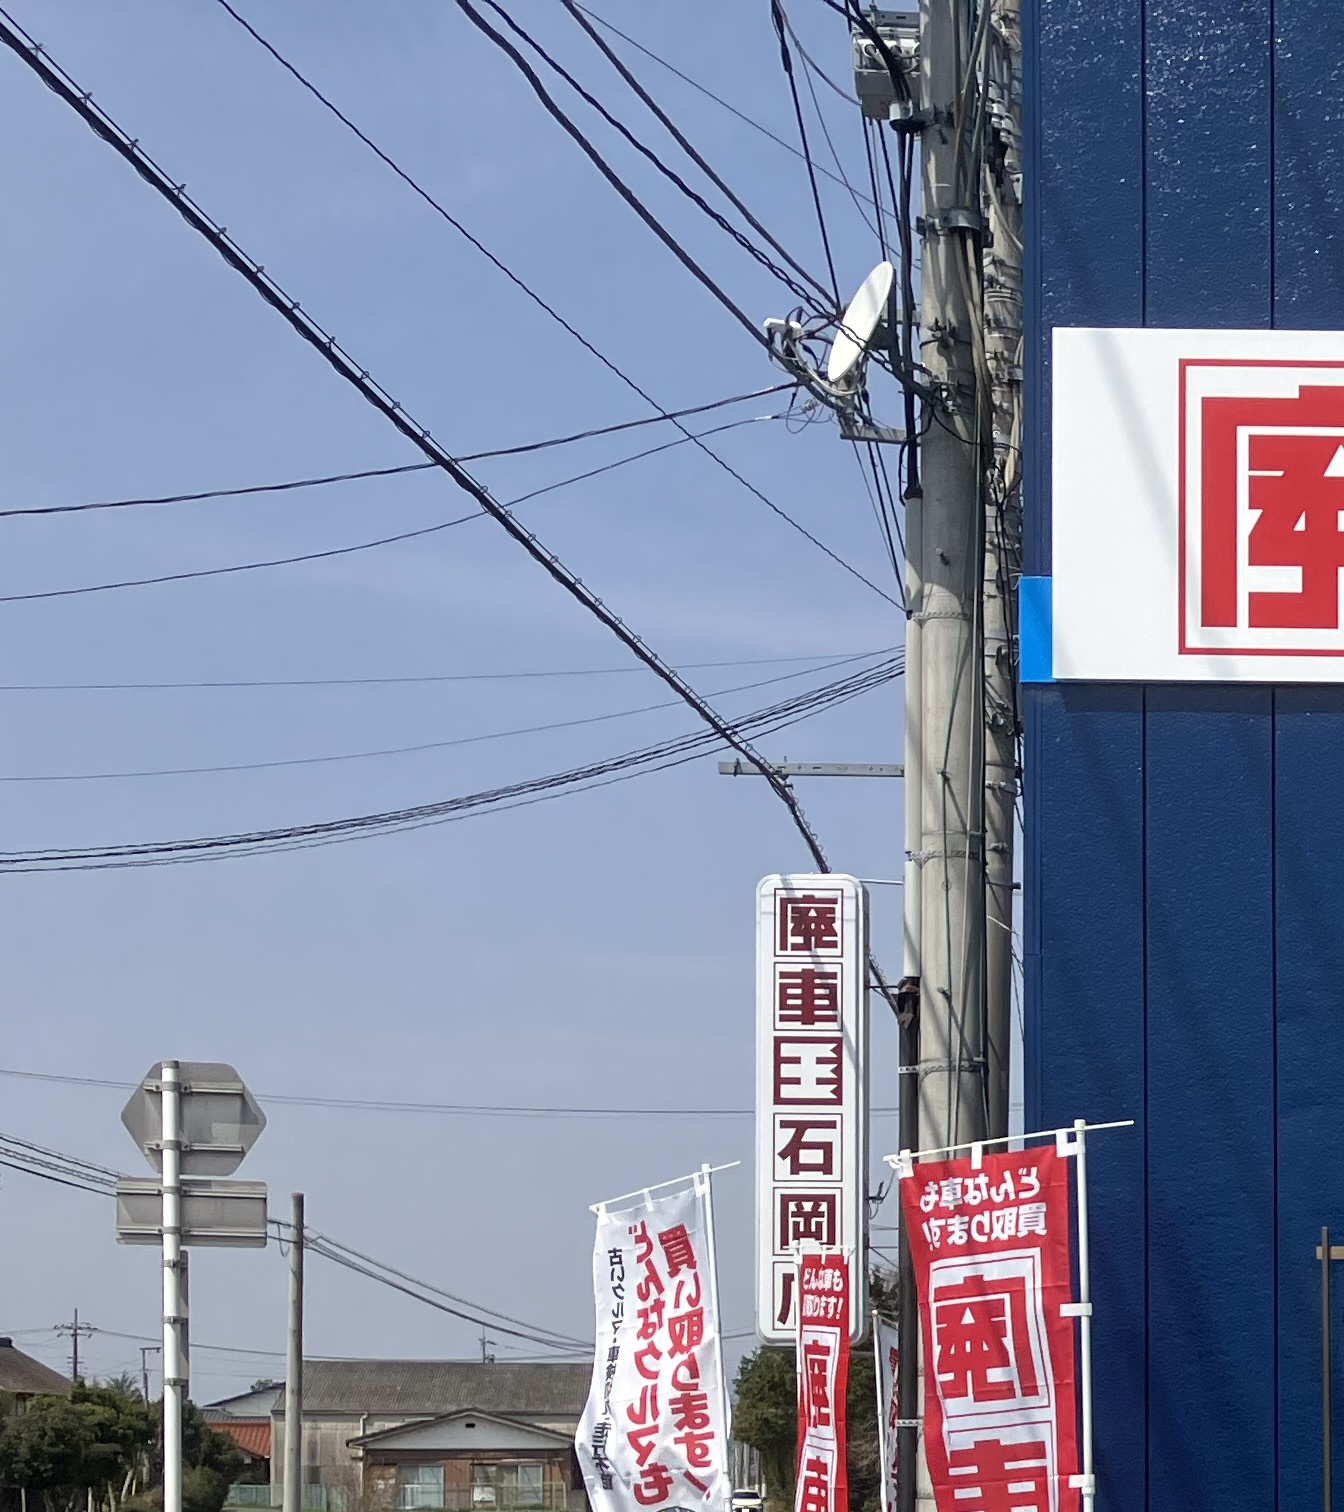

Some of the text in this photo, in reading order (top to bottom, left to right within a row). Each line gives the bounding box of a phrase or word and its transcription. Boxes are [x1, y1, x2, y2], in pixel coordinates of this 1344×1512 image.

[775, 893, 841, 1322] 廃車王石岡
